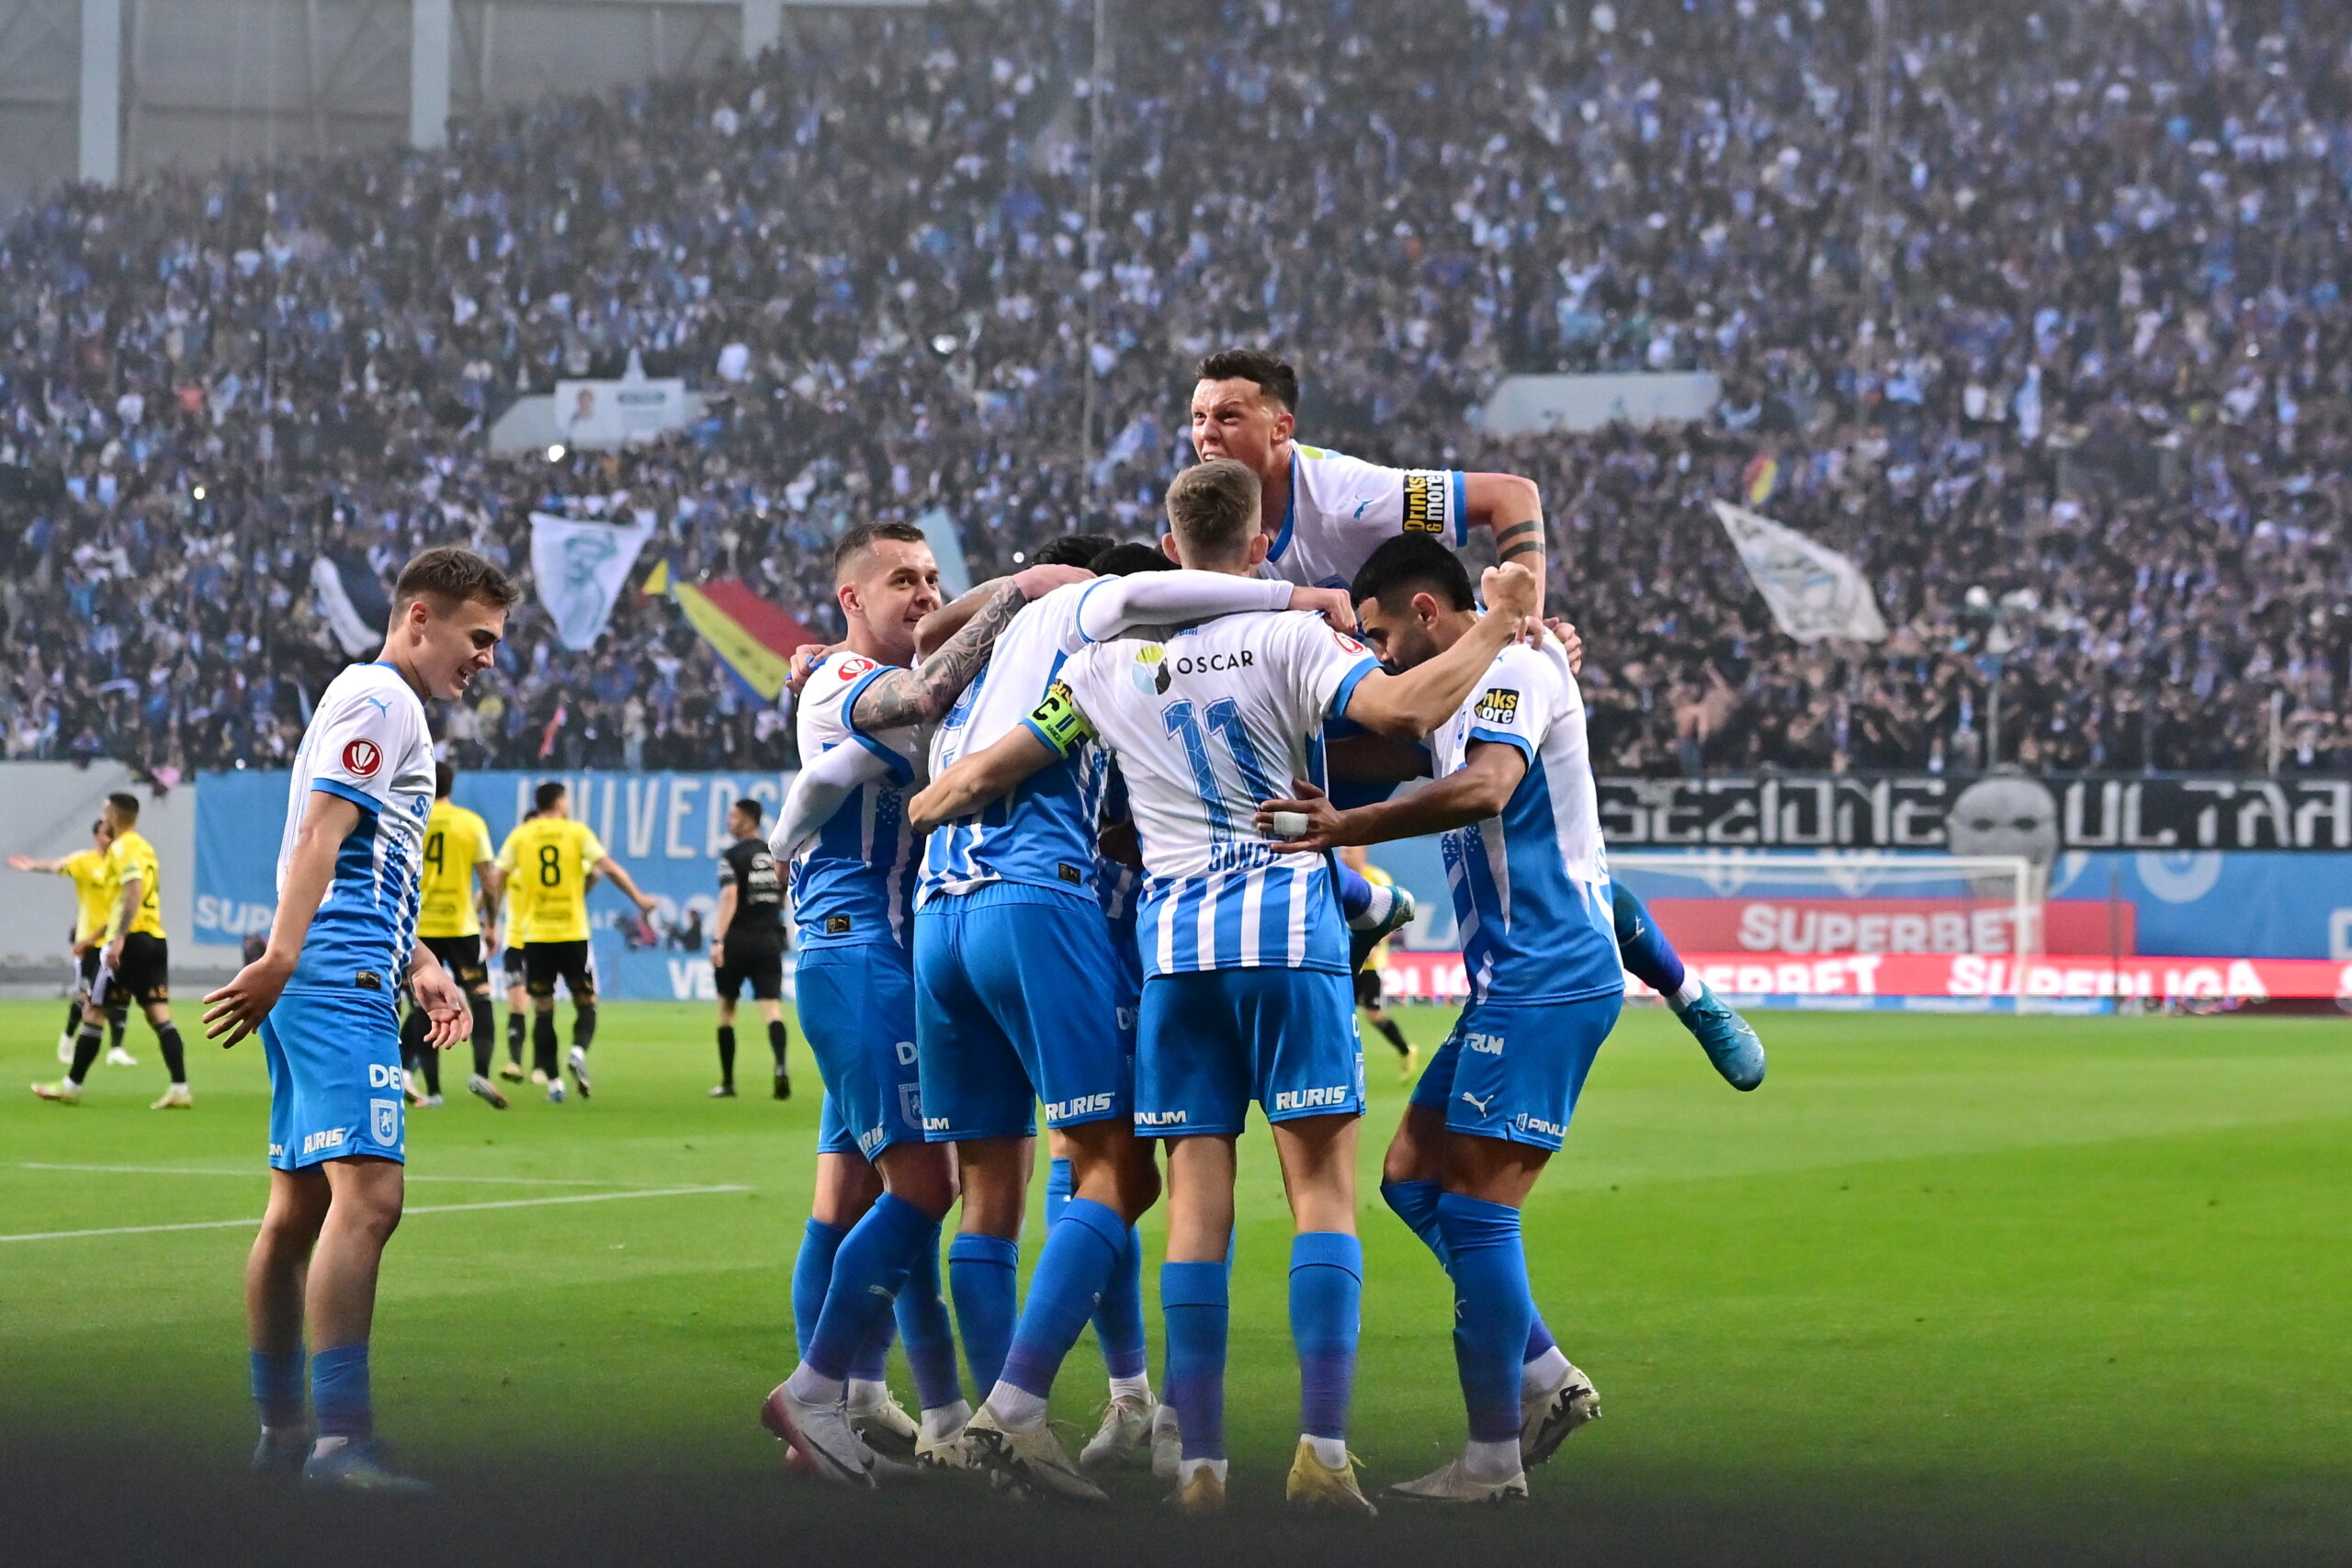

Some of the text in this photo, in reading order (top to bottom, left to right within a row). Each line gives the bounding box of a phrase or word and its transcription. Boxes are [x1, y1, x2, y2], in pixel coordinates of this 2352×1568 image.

[1404, 477, 1426, 531] Drinks
[1426, 476, 1444, 521] more
[1177, 650, 1254, 675] OSCAR
[1032, 697, 1060, 721] C
[1477, 706, 1514, 724] ore
[1161, 696, 1289, 843] 11
[422, 832, 444, 875] 4
[539, 845, 560, 887] 8
[1736, 901, 2043, 956] SUPERBET
[1045, 1092, 1115, 1121] RURIS
[1275, 1086, 1349, 1111] RURIS
